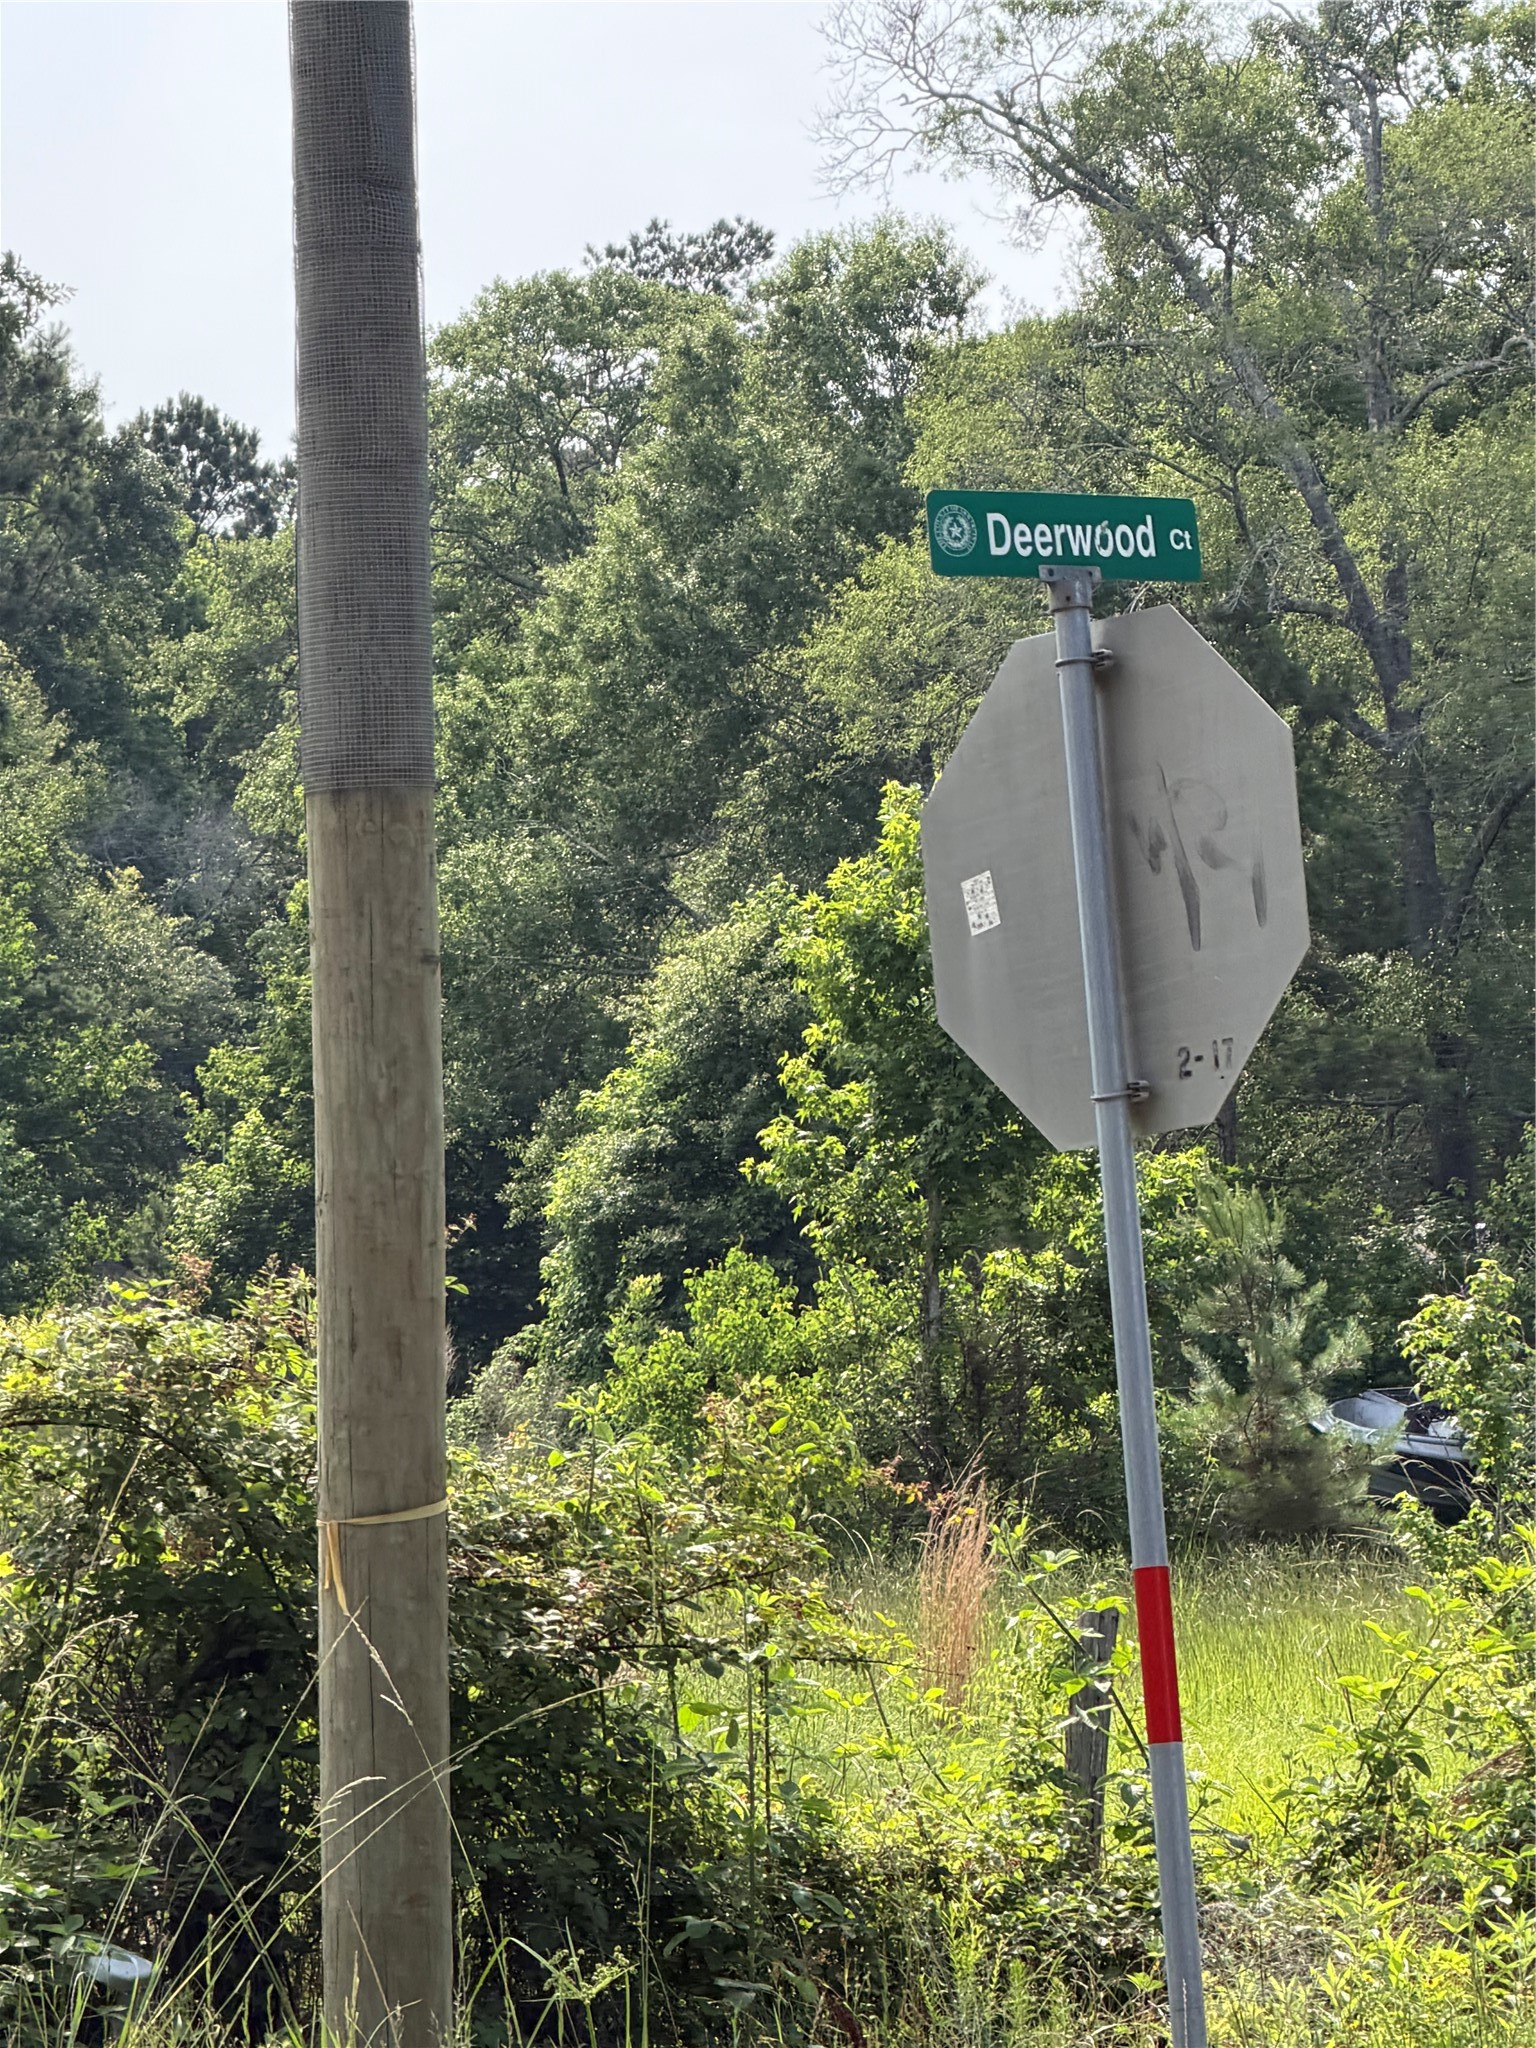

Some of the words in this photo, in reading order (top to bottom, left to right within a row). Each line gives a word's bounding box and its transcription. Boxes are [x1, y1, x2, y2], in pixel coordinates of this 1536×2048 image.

[986, 512, 1157, 558] Deerwood
[1169, 528, 1193, 550] Ct
[1177, 1037, 1234, 1080] 2-17
